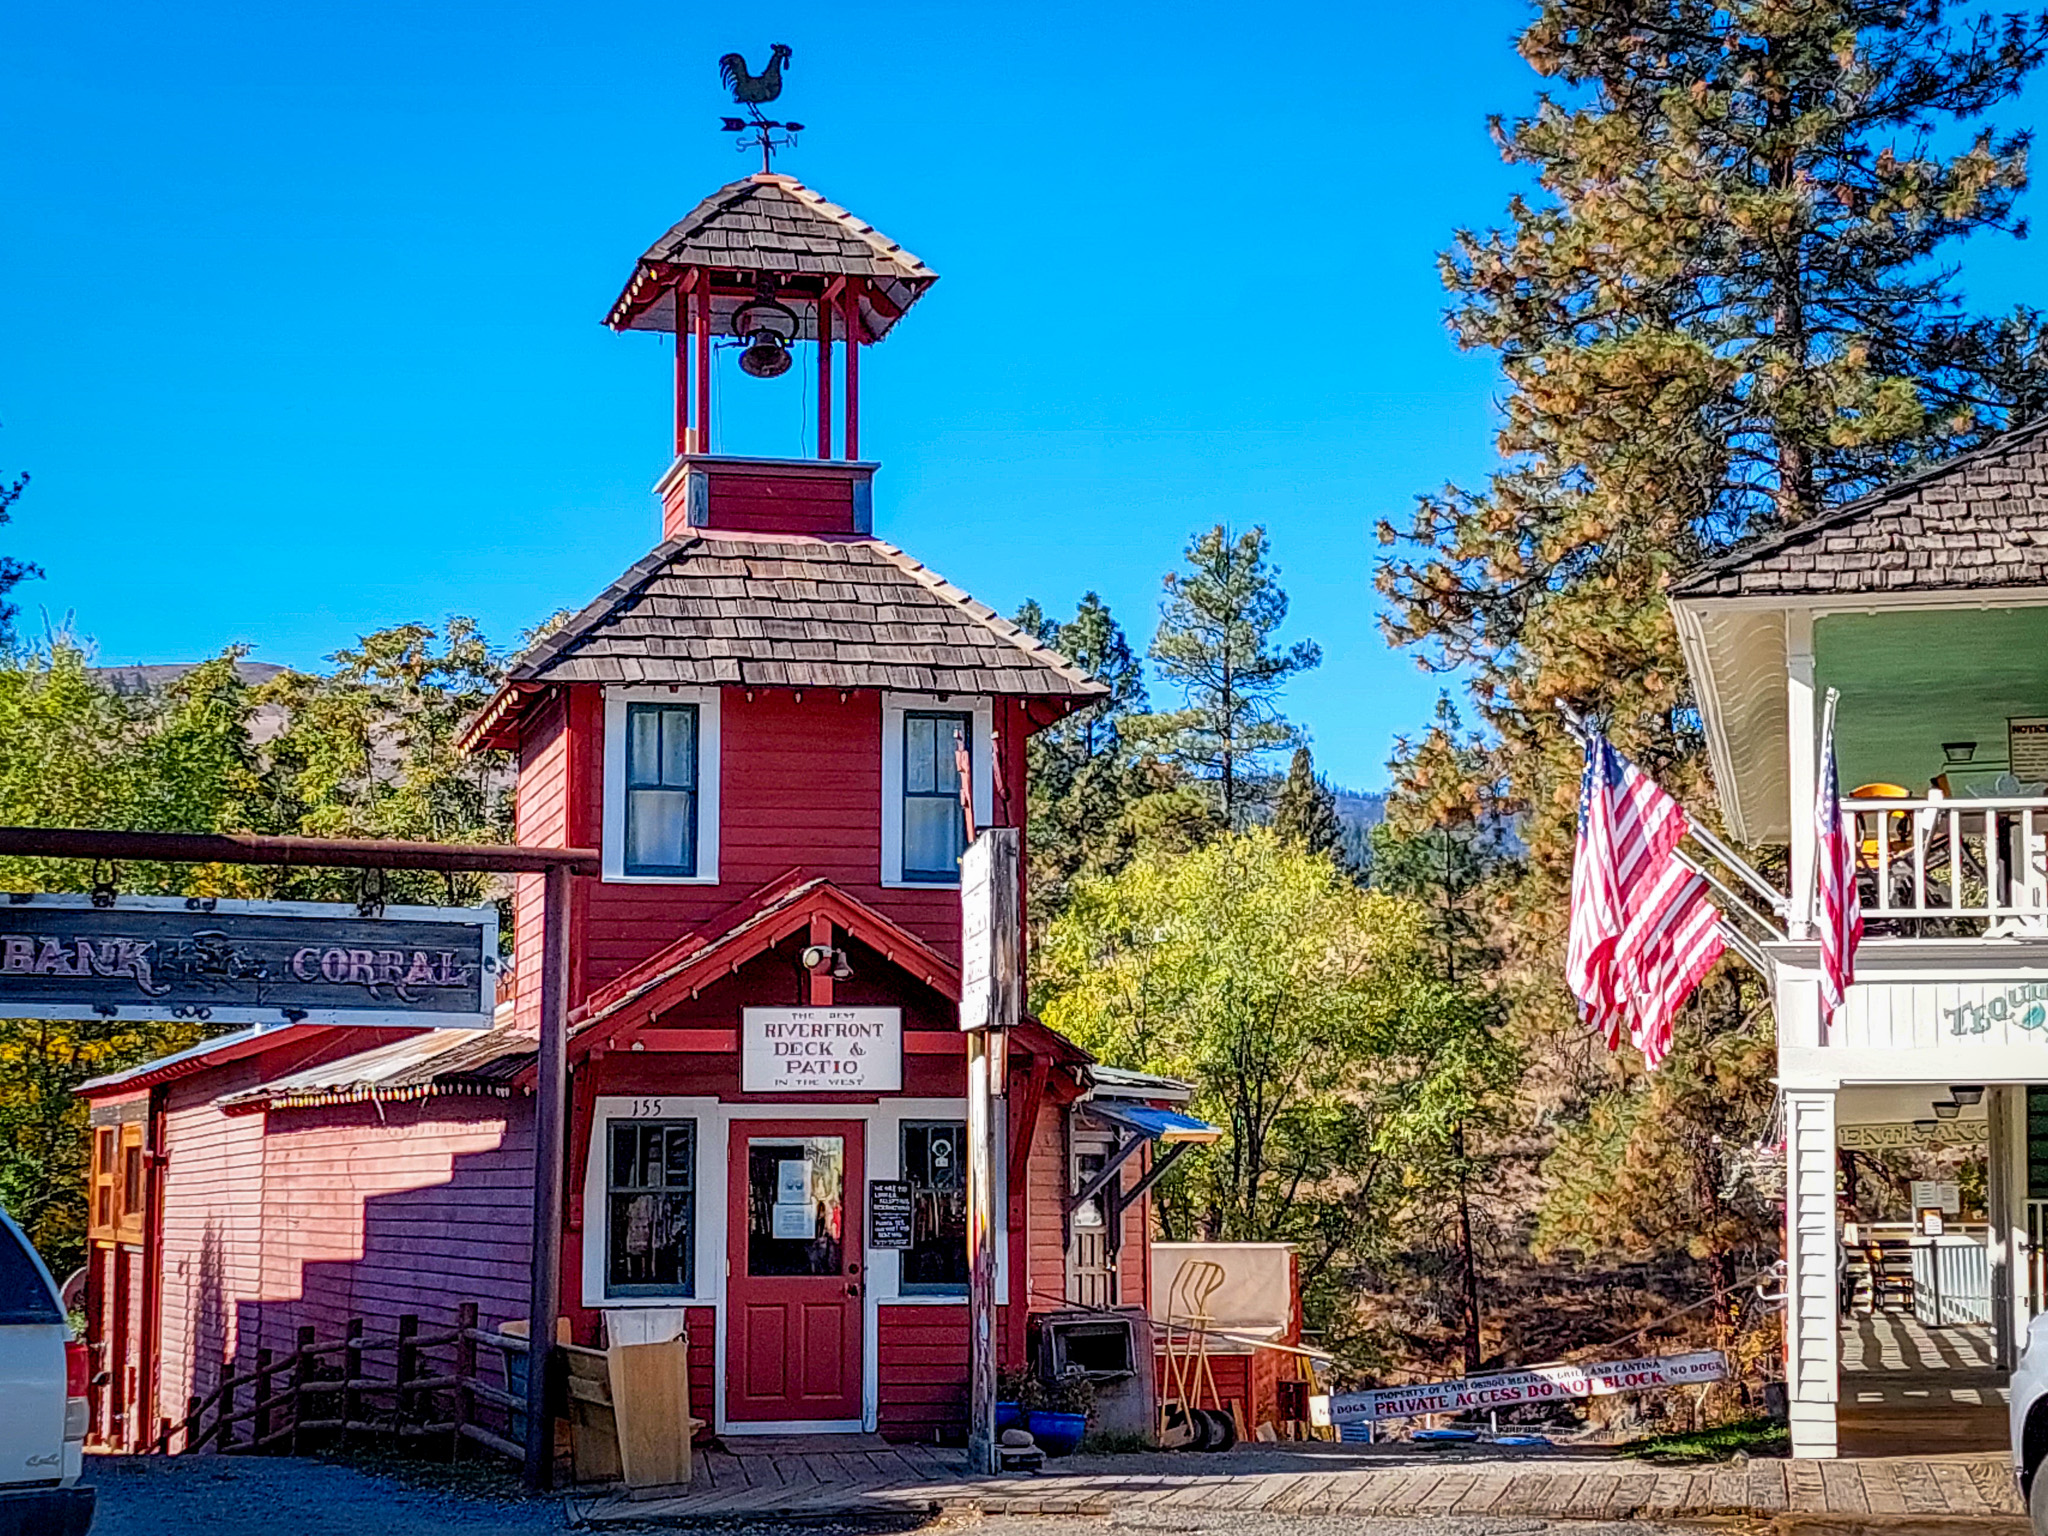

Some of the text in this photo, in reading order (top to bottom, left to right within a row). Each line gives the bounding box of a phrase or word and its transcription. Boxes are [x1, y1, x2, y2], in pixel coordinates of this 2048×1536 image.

[0, 935, 473, 1003] BANK CORRAL
[792, 1012, 815, 1020] THE
[764, 1023, 884, 1038] RIVERFRONT
[774, 1042, 867, 1056] DECK &
[785, 1060, 858, 1075] PATIO
[828, 1079, 863, 1087] WEST
[632, 1099, 661, 1116] 155
[1670, 1361, 1722, 1376] NO DOGS
[1374, 1388, 1427, 1401] PROPERTY
[1428, 1386, 1440, 1395] OF
[1507, 1373, 1554, 1385] MEXICAN
[1557, 1369, 1589, 1380] GRILL
[1591, 1366, 1612, 1375] AND
[1614, 1360, 1661, 1373] CANTINA
[1374, 1371, 1665, 1416] PRIVATE ACCESS DO NOT BLOCK
[1337, 1403, 1366, 1415] DOGS
